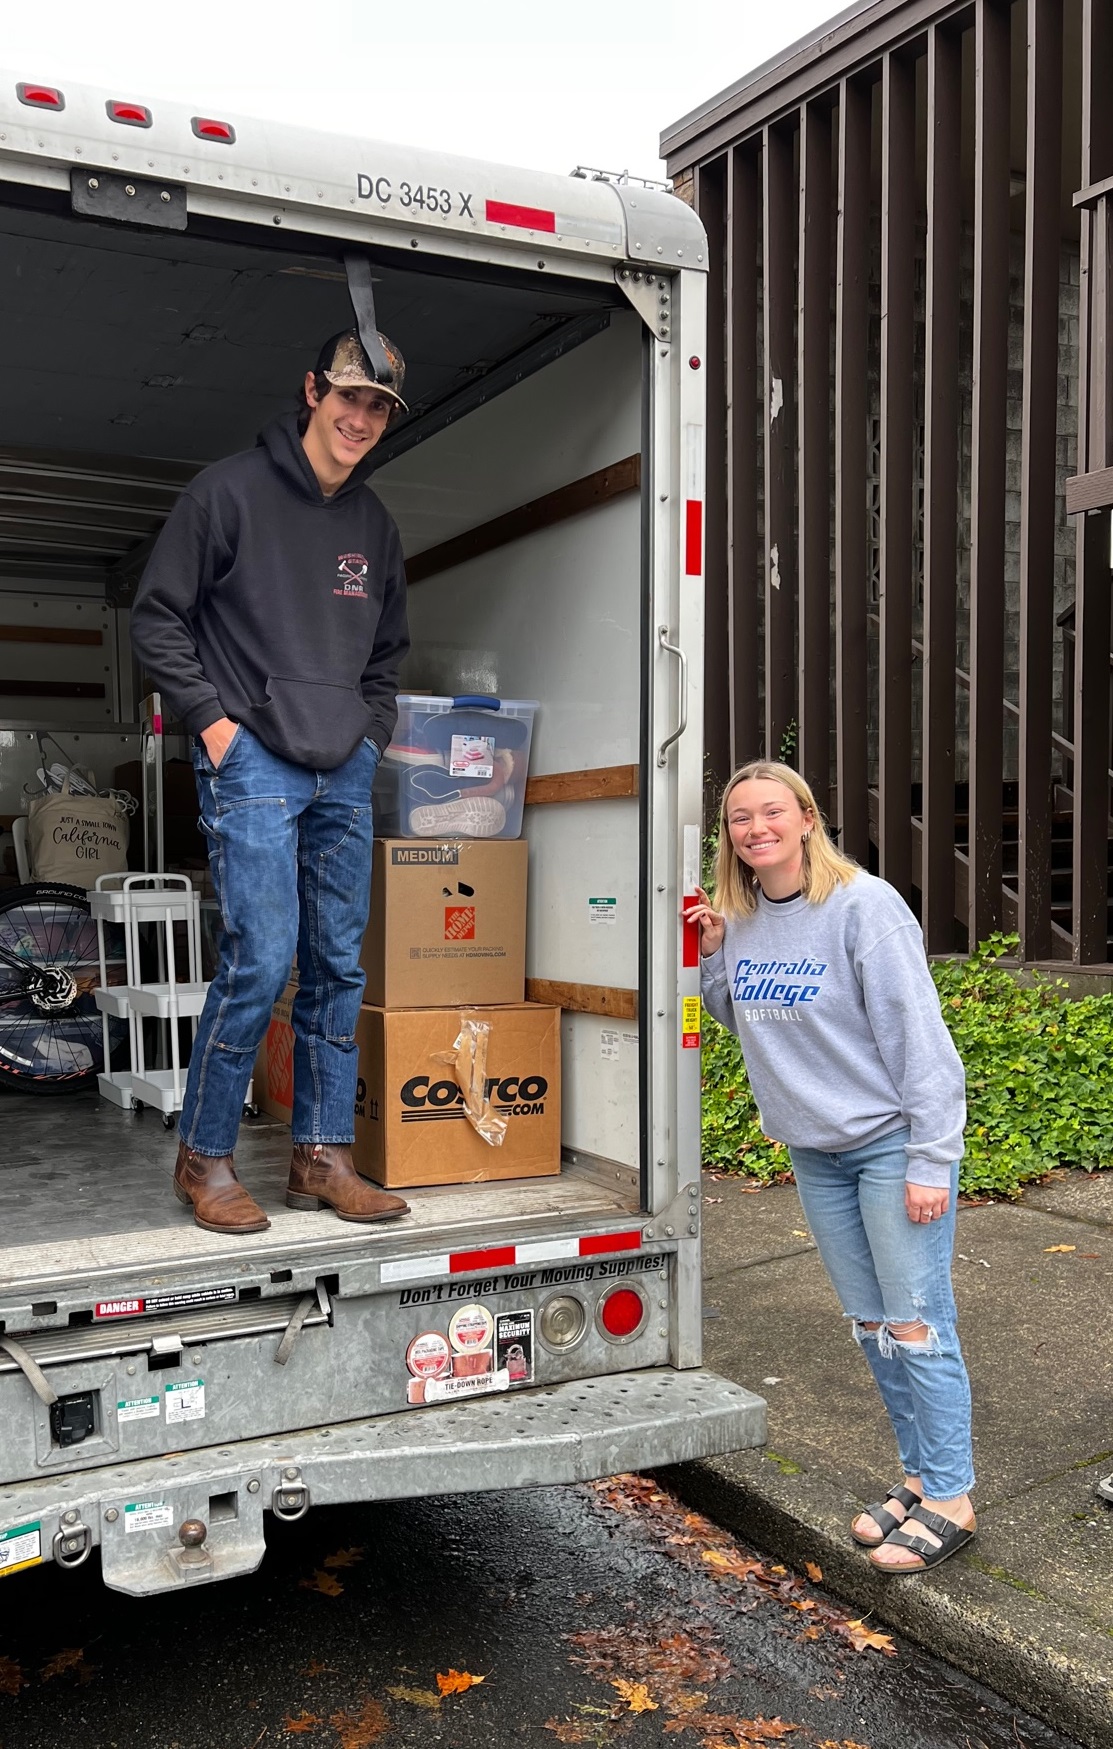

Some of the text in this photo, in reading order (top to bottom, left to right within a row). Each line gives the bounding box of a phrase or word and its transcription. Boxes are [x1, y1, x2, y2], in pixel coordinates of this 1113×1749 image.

[357, 173, 474, 218] DC 3453 X
[60, 816, 117, 832] JUST A SMALL TOWN
[52, 826, 121, 850] California
[75, 845, 101, 860] GIRL
[397, 850, 454, 863] MEDIUM
[36, 889, 73, 897] GROUND
[445, 906, 475, 940] HOME
[447, 910, 461, 925] THE
[455, 918, 475, 940] DEPOT
[734, 958, 828, 984] Centralia
[734, 976, 821, 1007] College
[744, 1009, 803, 1021] SOFTBALL
[508, 1103, 545, 1116] .COM
[400, 1254, 666, 1306] Don't Forget Your Moving Supplies!
[99, 1300, 139, 1315] DANGER
[499, 1322, 530, 1333] MAXIMUM
[499, 1328, 530, 1339] SECURITY
[173, 1380, 198, 1390] ATTENTION
[445, 1379, 476, 1391] TIE-DOWN
[477, 1376, 493, 1386] ROPE
[125, 1398, 152, 1407] ATTENTION
